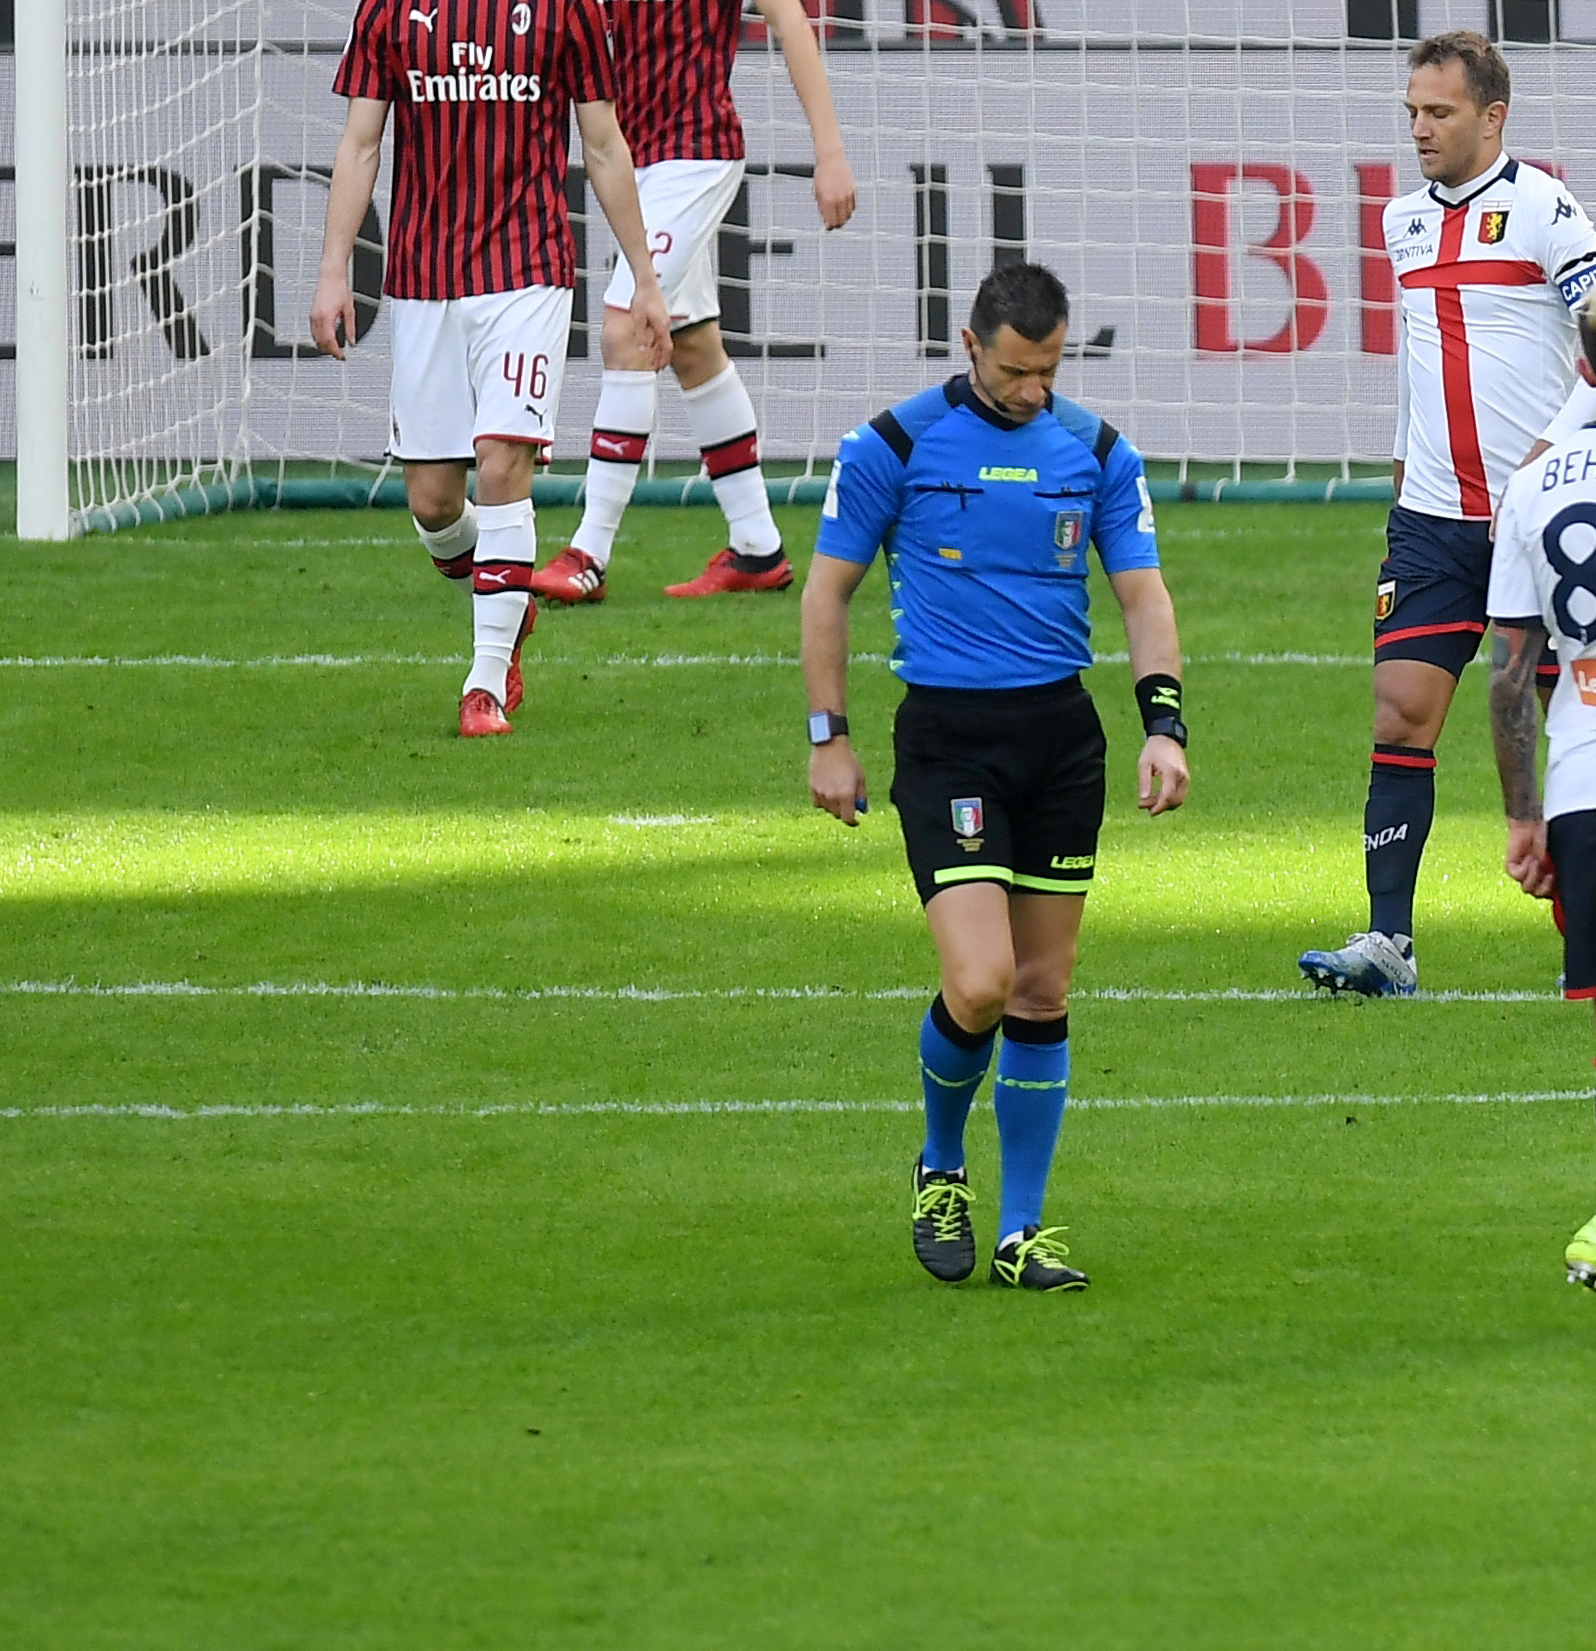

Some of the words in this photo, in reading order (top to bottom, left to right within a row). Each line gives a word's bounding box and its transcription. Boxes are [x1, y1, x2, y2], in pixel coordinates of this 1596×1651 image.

[452, 42, 493, 70] Fly
[406, 66, 541, 103] Emirates
[503, 351, 549, 400] 46
[978, 466, 1039, 483] LEGEA
